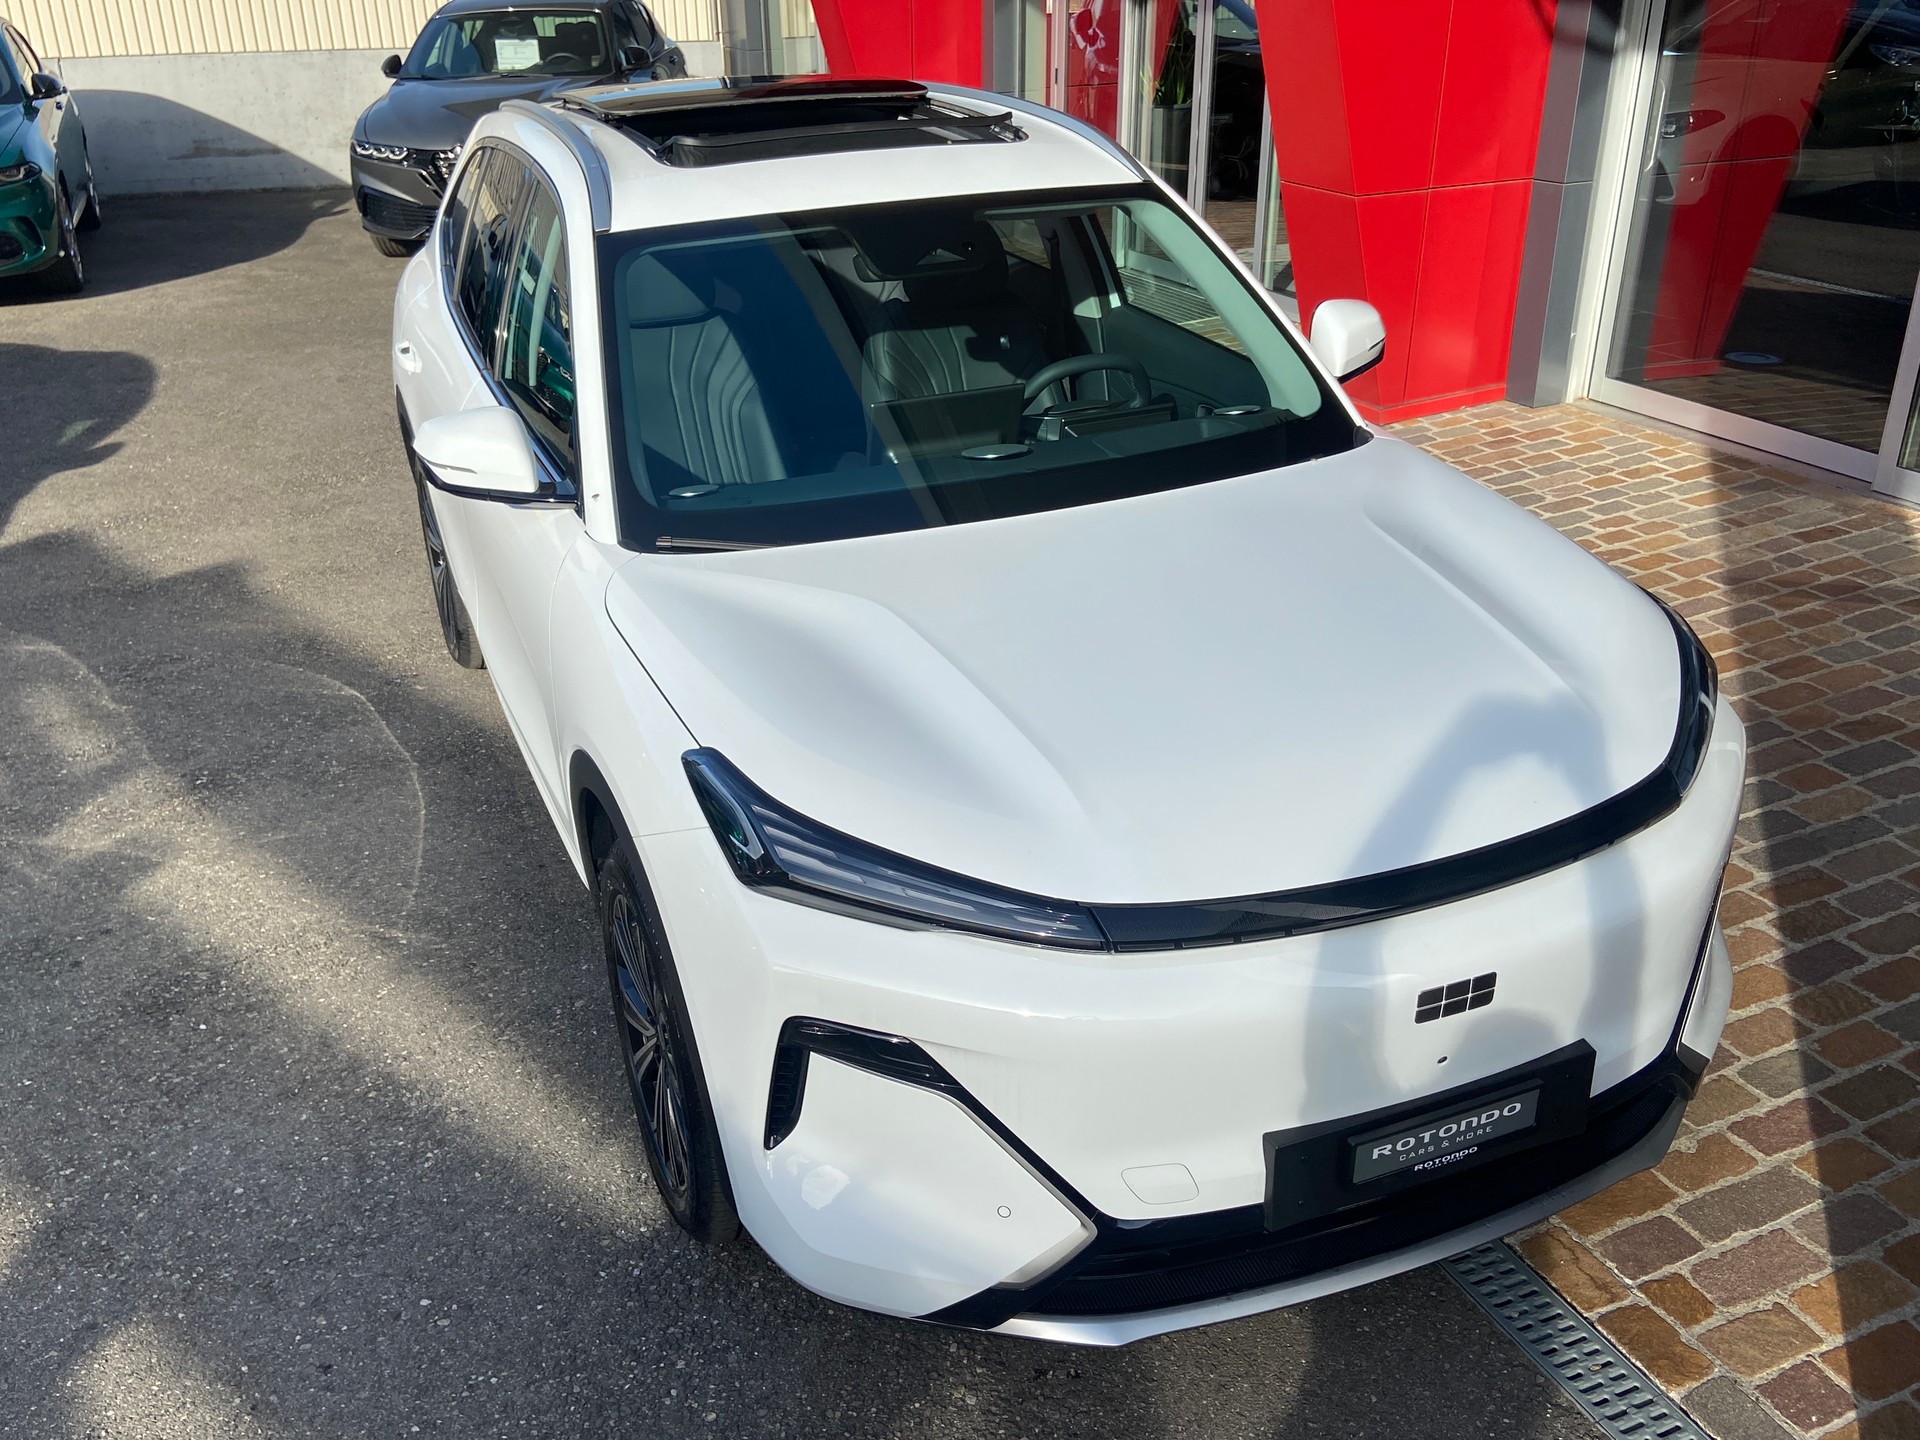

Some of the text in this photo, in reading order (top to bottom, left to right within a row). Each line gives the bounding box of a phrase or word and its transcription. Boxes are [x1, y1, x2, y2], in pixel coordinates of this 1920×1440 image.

[1372, 1102, 1522, 1160] ROTONDO
[1399, 1125, 1493, 1162] CARS & MORE
[1414, 1146, 1478, 1171] ROTONDO
